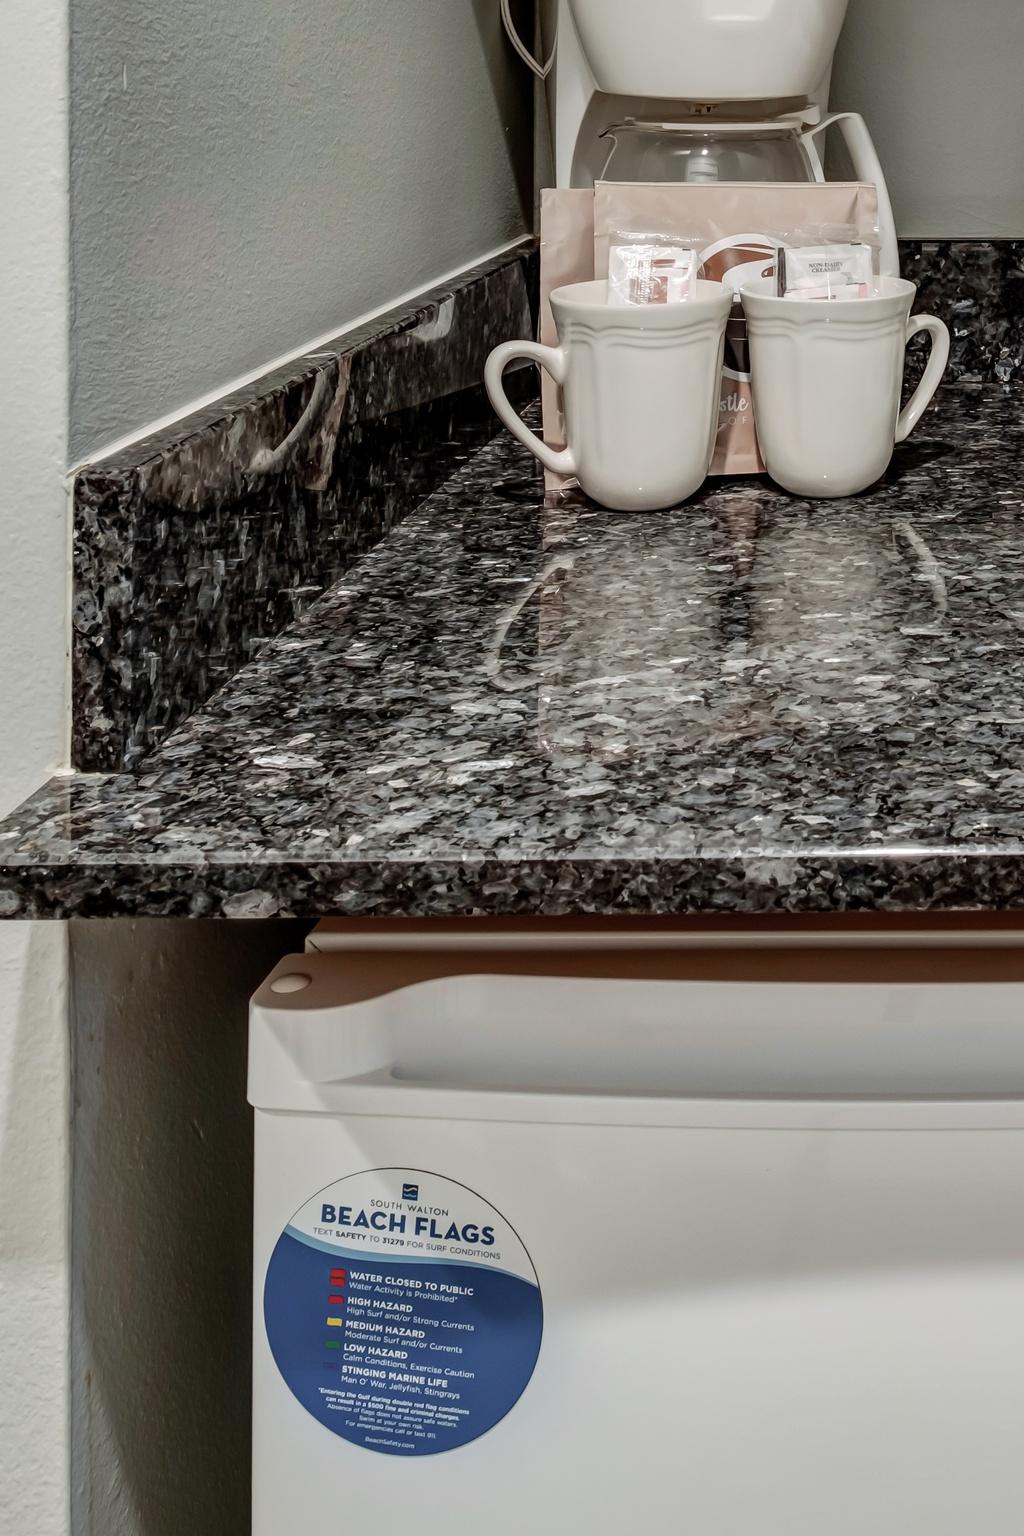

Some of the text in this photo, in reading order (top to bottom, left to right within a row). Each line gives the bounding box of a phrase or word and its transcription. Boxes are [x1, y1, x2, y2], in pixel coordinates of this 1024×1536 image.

[719, 393, 750, 412] stle
[370, 1199, 449, 1216] SOUTH WALTON
[321, 1203, 495, 1246] BEACH FLAGS
[312, 1227, 501, 1260] TEXT SAFETY TO 31279 FOR SURF CONDITIONS
[349, 1271, 474, 1296] WATER CLOSED TO PUBLIC
[349, 1281, 372, 1291] Water
[374, 1285, 404, 1297] Activity
[406, 1289, 413, 1298] is
[347, 1296, 413, 1313] HIGH HAZARD
[345, 1319, 425, 1339] MEDIUM HAZARD
[346, 1306, 475, 1332] High Surf and/or Strong Currents
[343, 1343, 408, 1360] LOW HAZARD
[344, 1330, 463, 1354] Moderate Surf and/or Currents
[341, 1364, 448, 1388] STINGING MARINE LIFE
[342, 1353, 363, 1362] Calm
[410, 1362, 442, 1374] Exercise
[444, 1368, 475, 1379] Caution
[341, 1375, 357, 1384] Man
[424, 1387, 460, 1400] Stingrays
[357, 1393, 371, 1401] Gulf
[371, 1396, 391, 1404] during
